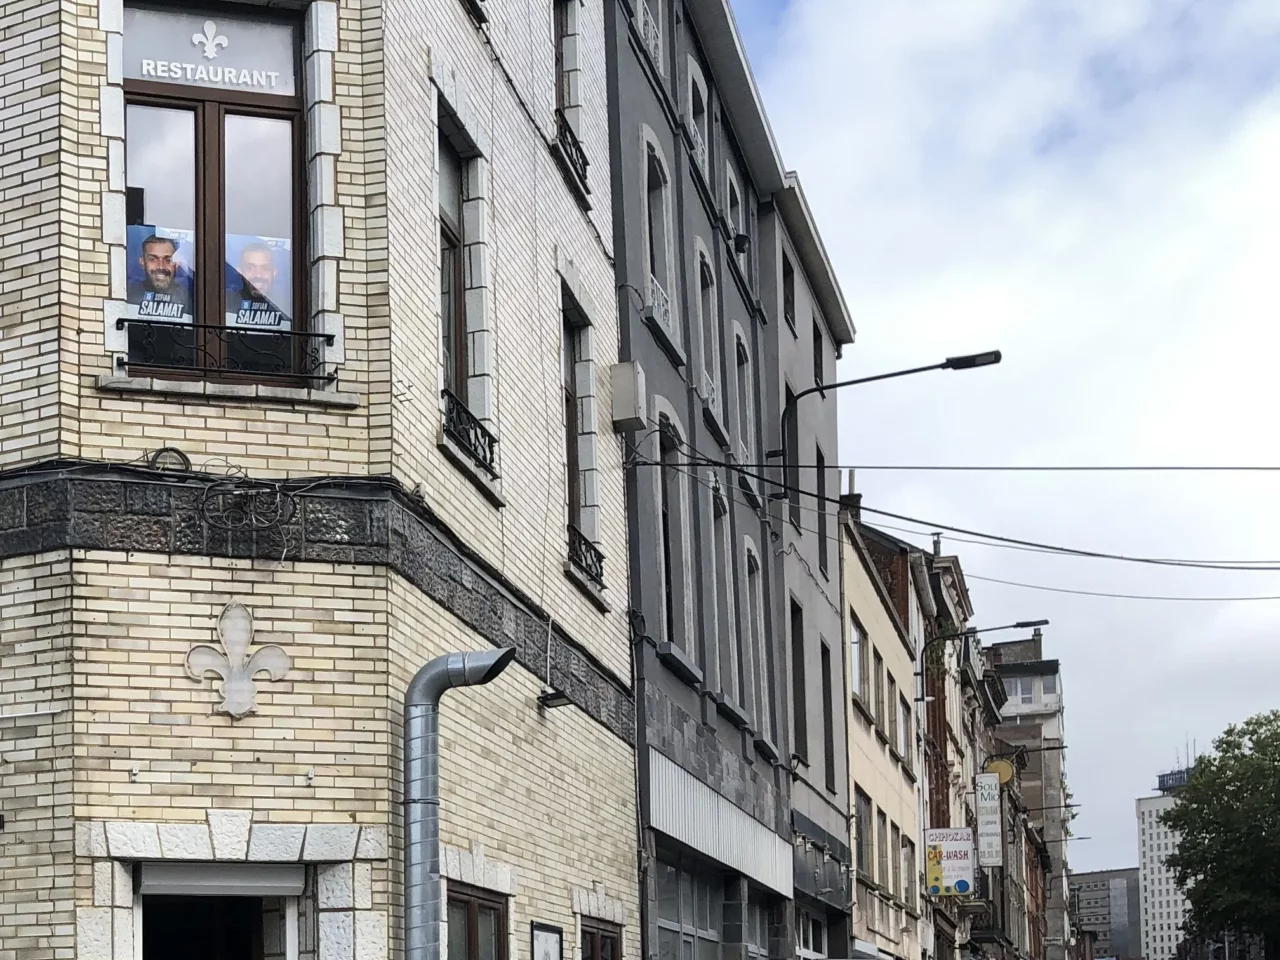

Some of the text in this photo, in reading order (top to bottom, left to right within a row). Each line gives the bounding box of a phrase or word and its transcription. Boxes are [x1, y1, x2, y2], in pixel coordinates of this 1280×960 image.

[142, 59, 279, 87] RESTAURANT
[140, 301, 184, 318] SALAMAT
[237, 310, 281, 326] SALAMAT
[928, 850, 969, 861] CAR-WASH
